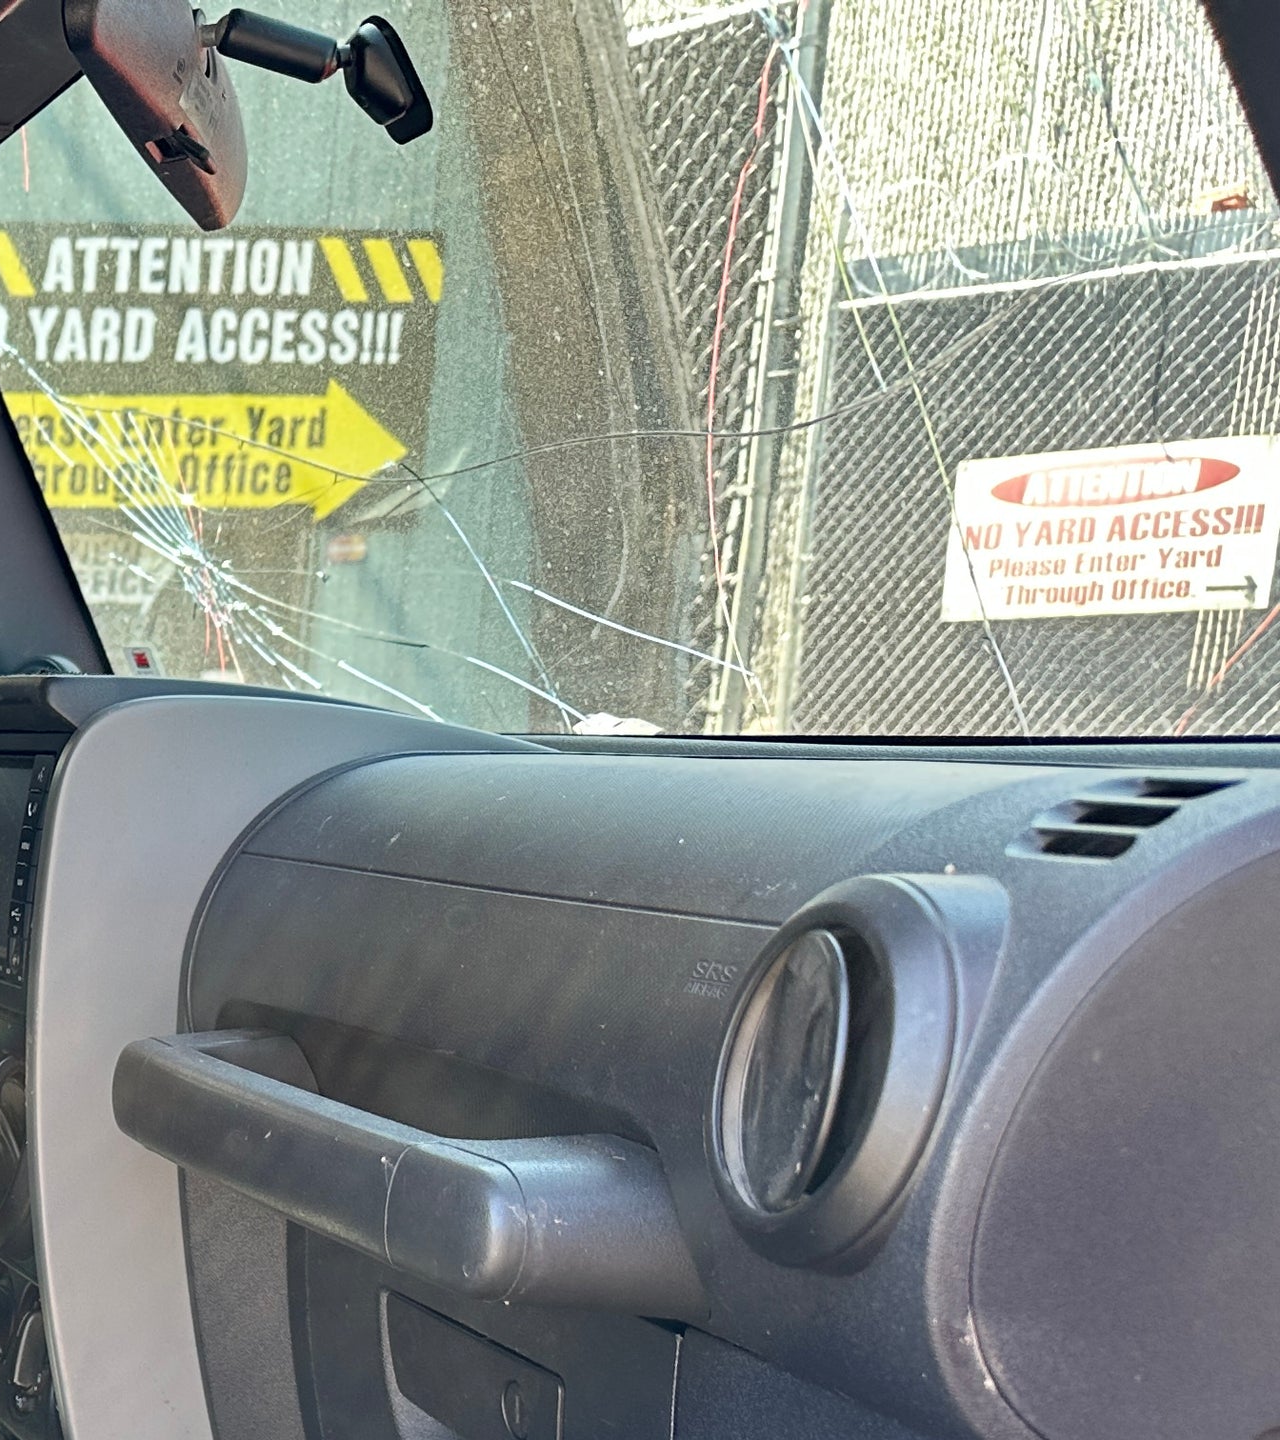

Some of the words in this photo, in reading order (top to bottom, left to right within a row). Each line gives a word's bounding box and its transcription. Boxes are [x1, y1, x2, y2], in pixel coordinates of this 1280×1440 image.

[42, 236, 316, 296] ATTENTION
[27, 304, 157, 363] YARD
[173, 307, 406, 365] ACCESS!!!
[15, 414, 101, 449] ease
[246, 404, 328, 449] Yard
[31, 452, 160, 503] hrough
[175, 451, 293, 495] Office
[1021, 458, 1202, 506] ATTENTION
[964, 523, 1003, 551] NO
[1015, 515, 1096, 549] YARD
[1106, 503, 1266, 543] ACCESS!!!
[988, 557, 1066, 579] Please
[1074, 551, 1147, 575] Enter
[1158, 544, 1223, 569] Yard
[1005, 580, 1104, 606] Through
[692, 960, 739, 983] SRS
